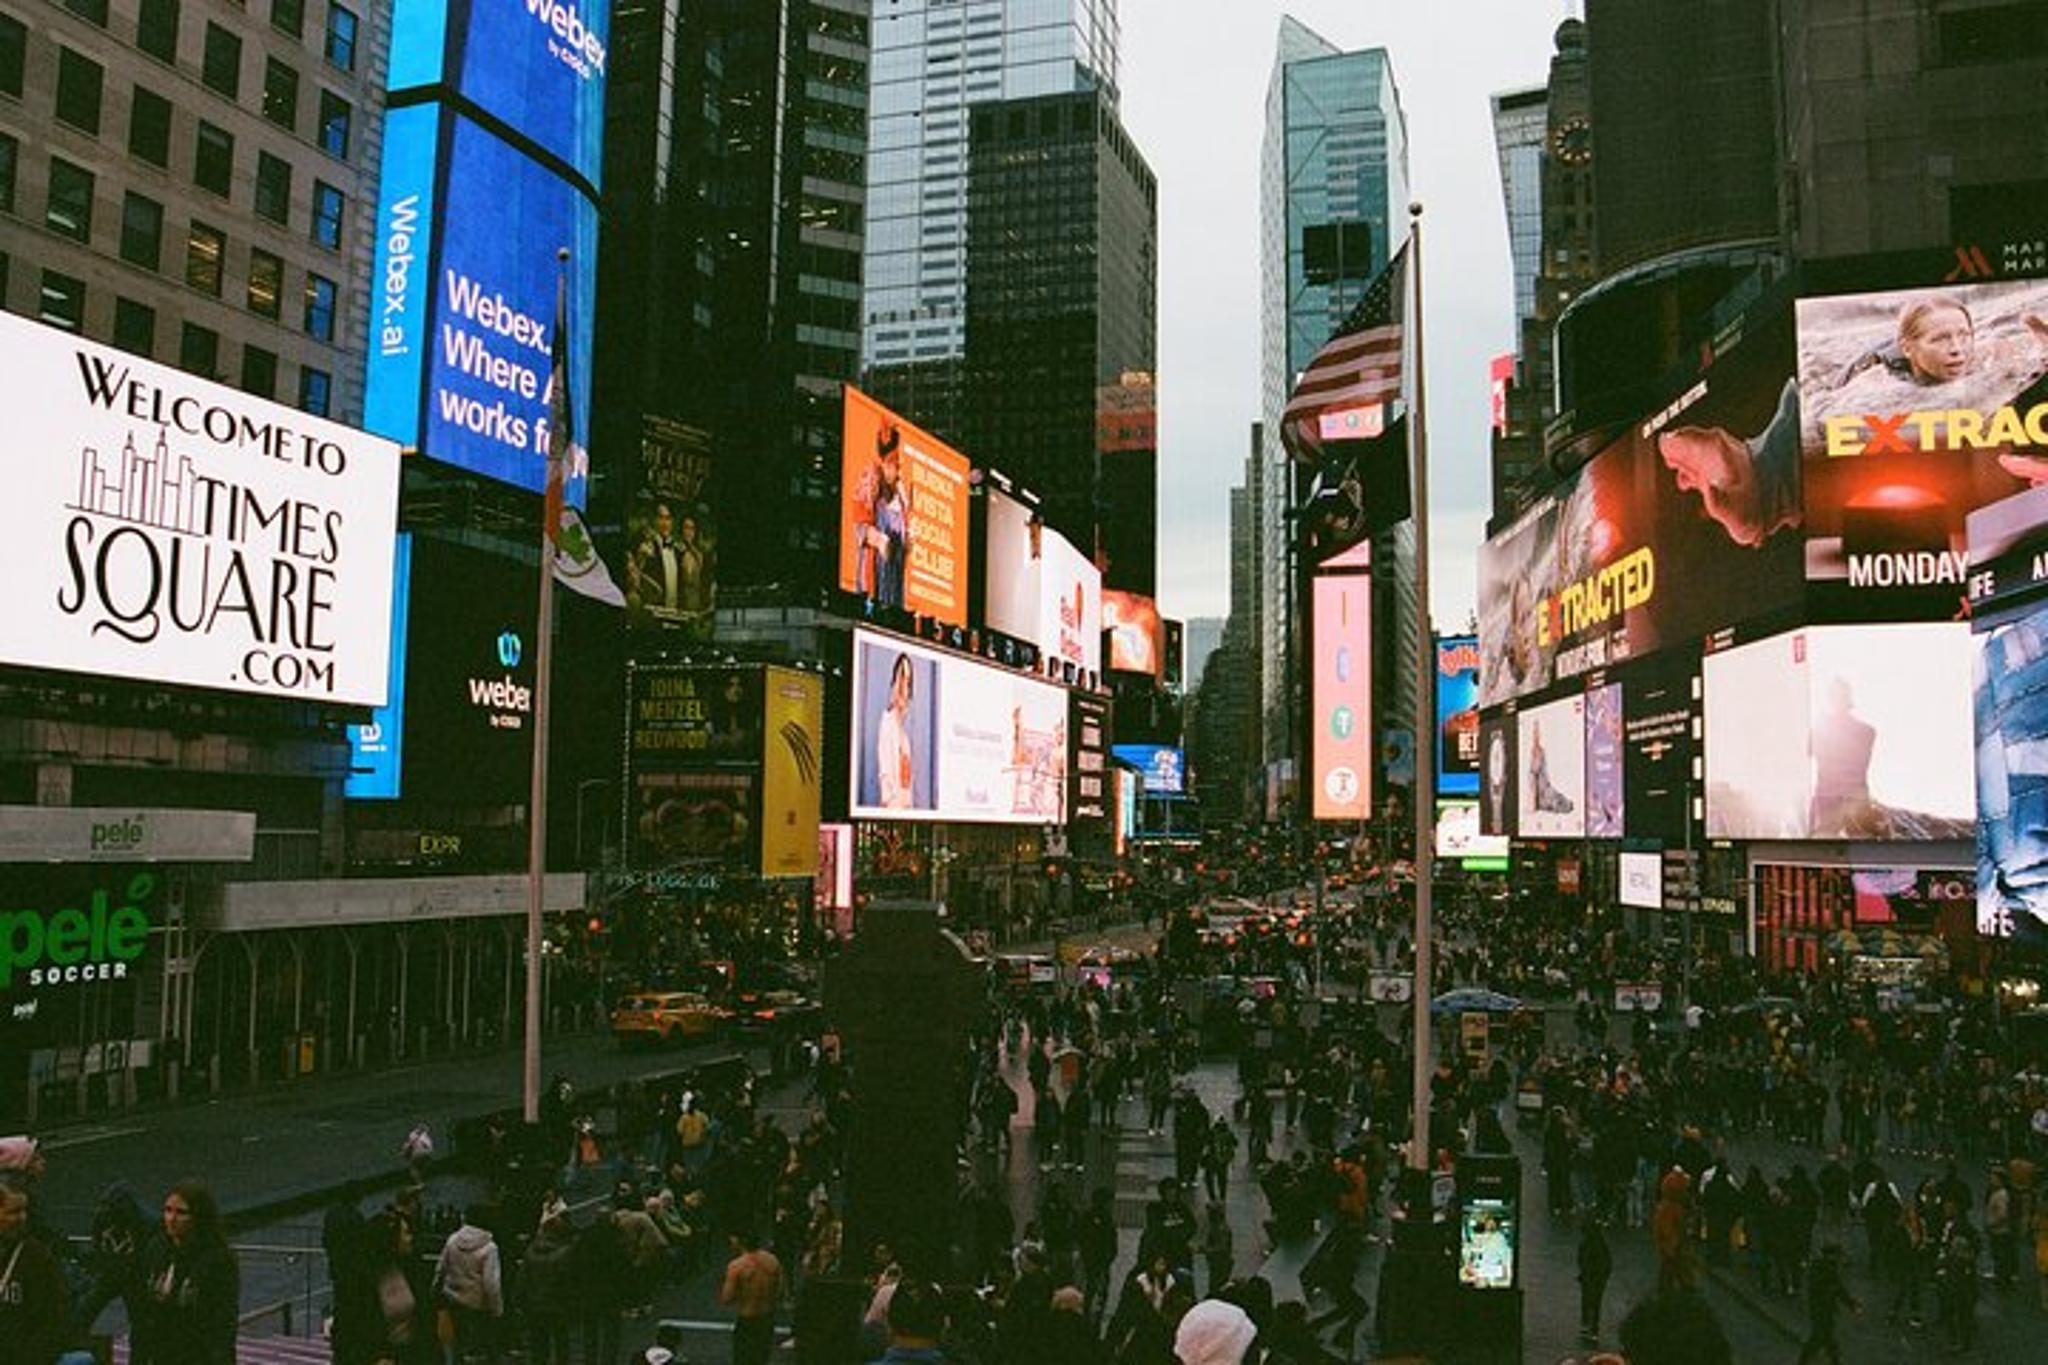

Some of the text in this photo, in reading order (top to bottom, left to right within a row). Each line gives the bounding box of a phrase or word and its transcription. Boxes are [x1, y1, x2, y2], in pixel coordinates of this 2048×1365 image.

[381, 195, 420, 356] Webex.ai
[447, 269, 551, 356] Webex.
[443, 324, 537, 399] Where
[75, 351, 347, 476] WELCOME TO
[440, 388, 528, 456] works
[1825, 402, 2048, 457] EXTRAC
[197, 475, 343, 564] TIMES
[57, 515, 337, 653] SQUARE
[910, 541, 954, 581] CLUB
[1535, 546, 1655, 648] EXTRACTED
[1849, 550, 1969, 587] MONDAY
[230, 649, 335, 693] .COM
[640, 701, 704, 720] MENZEL
[0, 871, 155, 988] pelé
[30, 962, 127, 986] SOCCER
